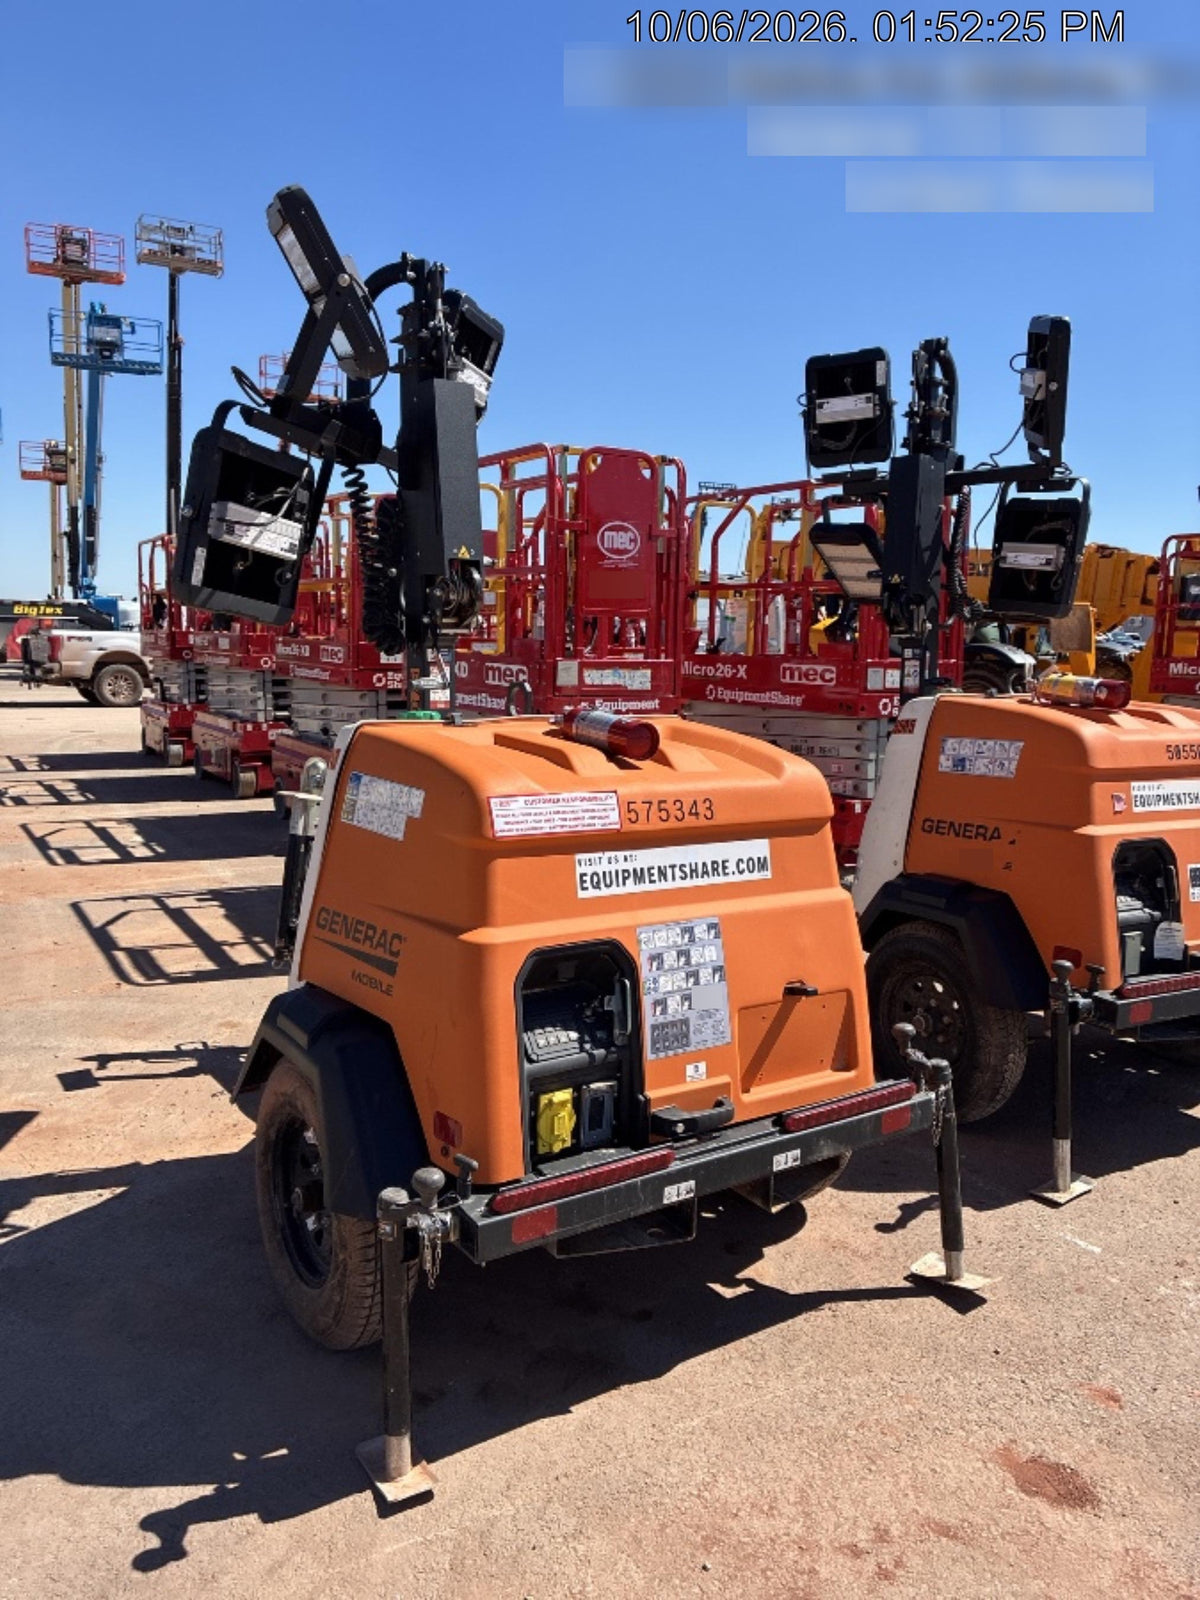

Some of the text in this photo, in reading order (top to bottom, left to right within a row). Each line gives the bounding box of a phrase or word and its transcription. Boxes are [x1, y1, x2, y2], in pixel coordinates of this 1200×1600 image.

[603, 530, 636, 550] mec
[485, 662, 528, 687] mec
[780, 663, 836, 685] mec
[1168, 661, 1200, 676] Mic
[594, 697, 660, 712] Equipment
[717, 687, 803, 707] EquipmentShare
[626, 797, 715, 825] 575343
[921, 818, 1017, 846] GENERA
[578, 855, 769, 892] EQUIPMENTSHARE.COM
[315, 905, 405, 959] GENERAC
[351, 969, 395, 997] MOBILE
